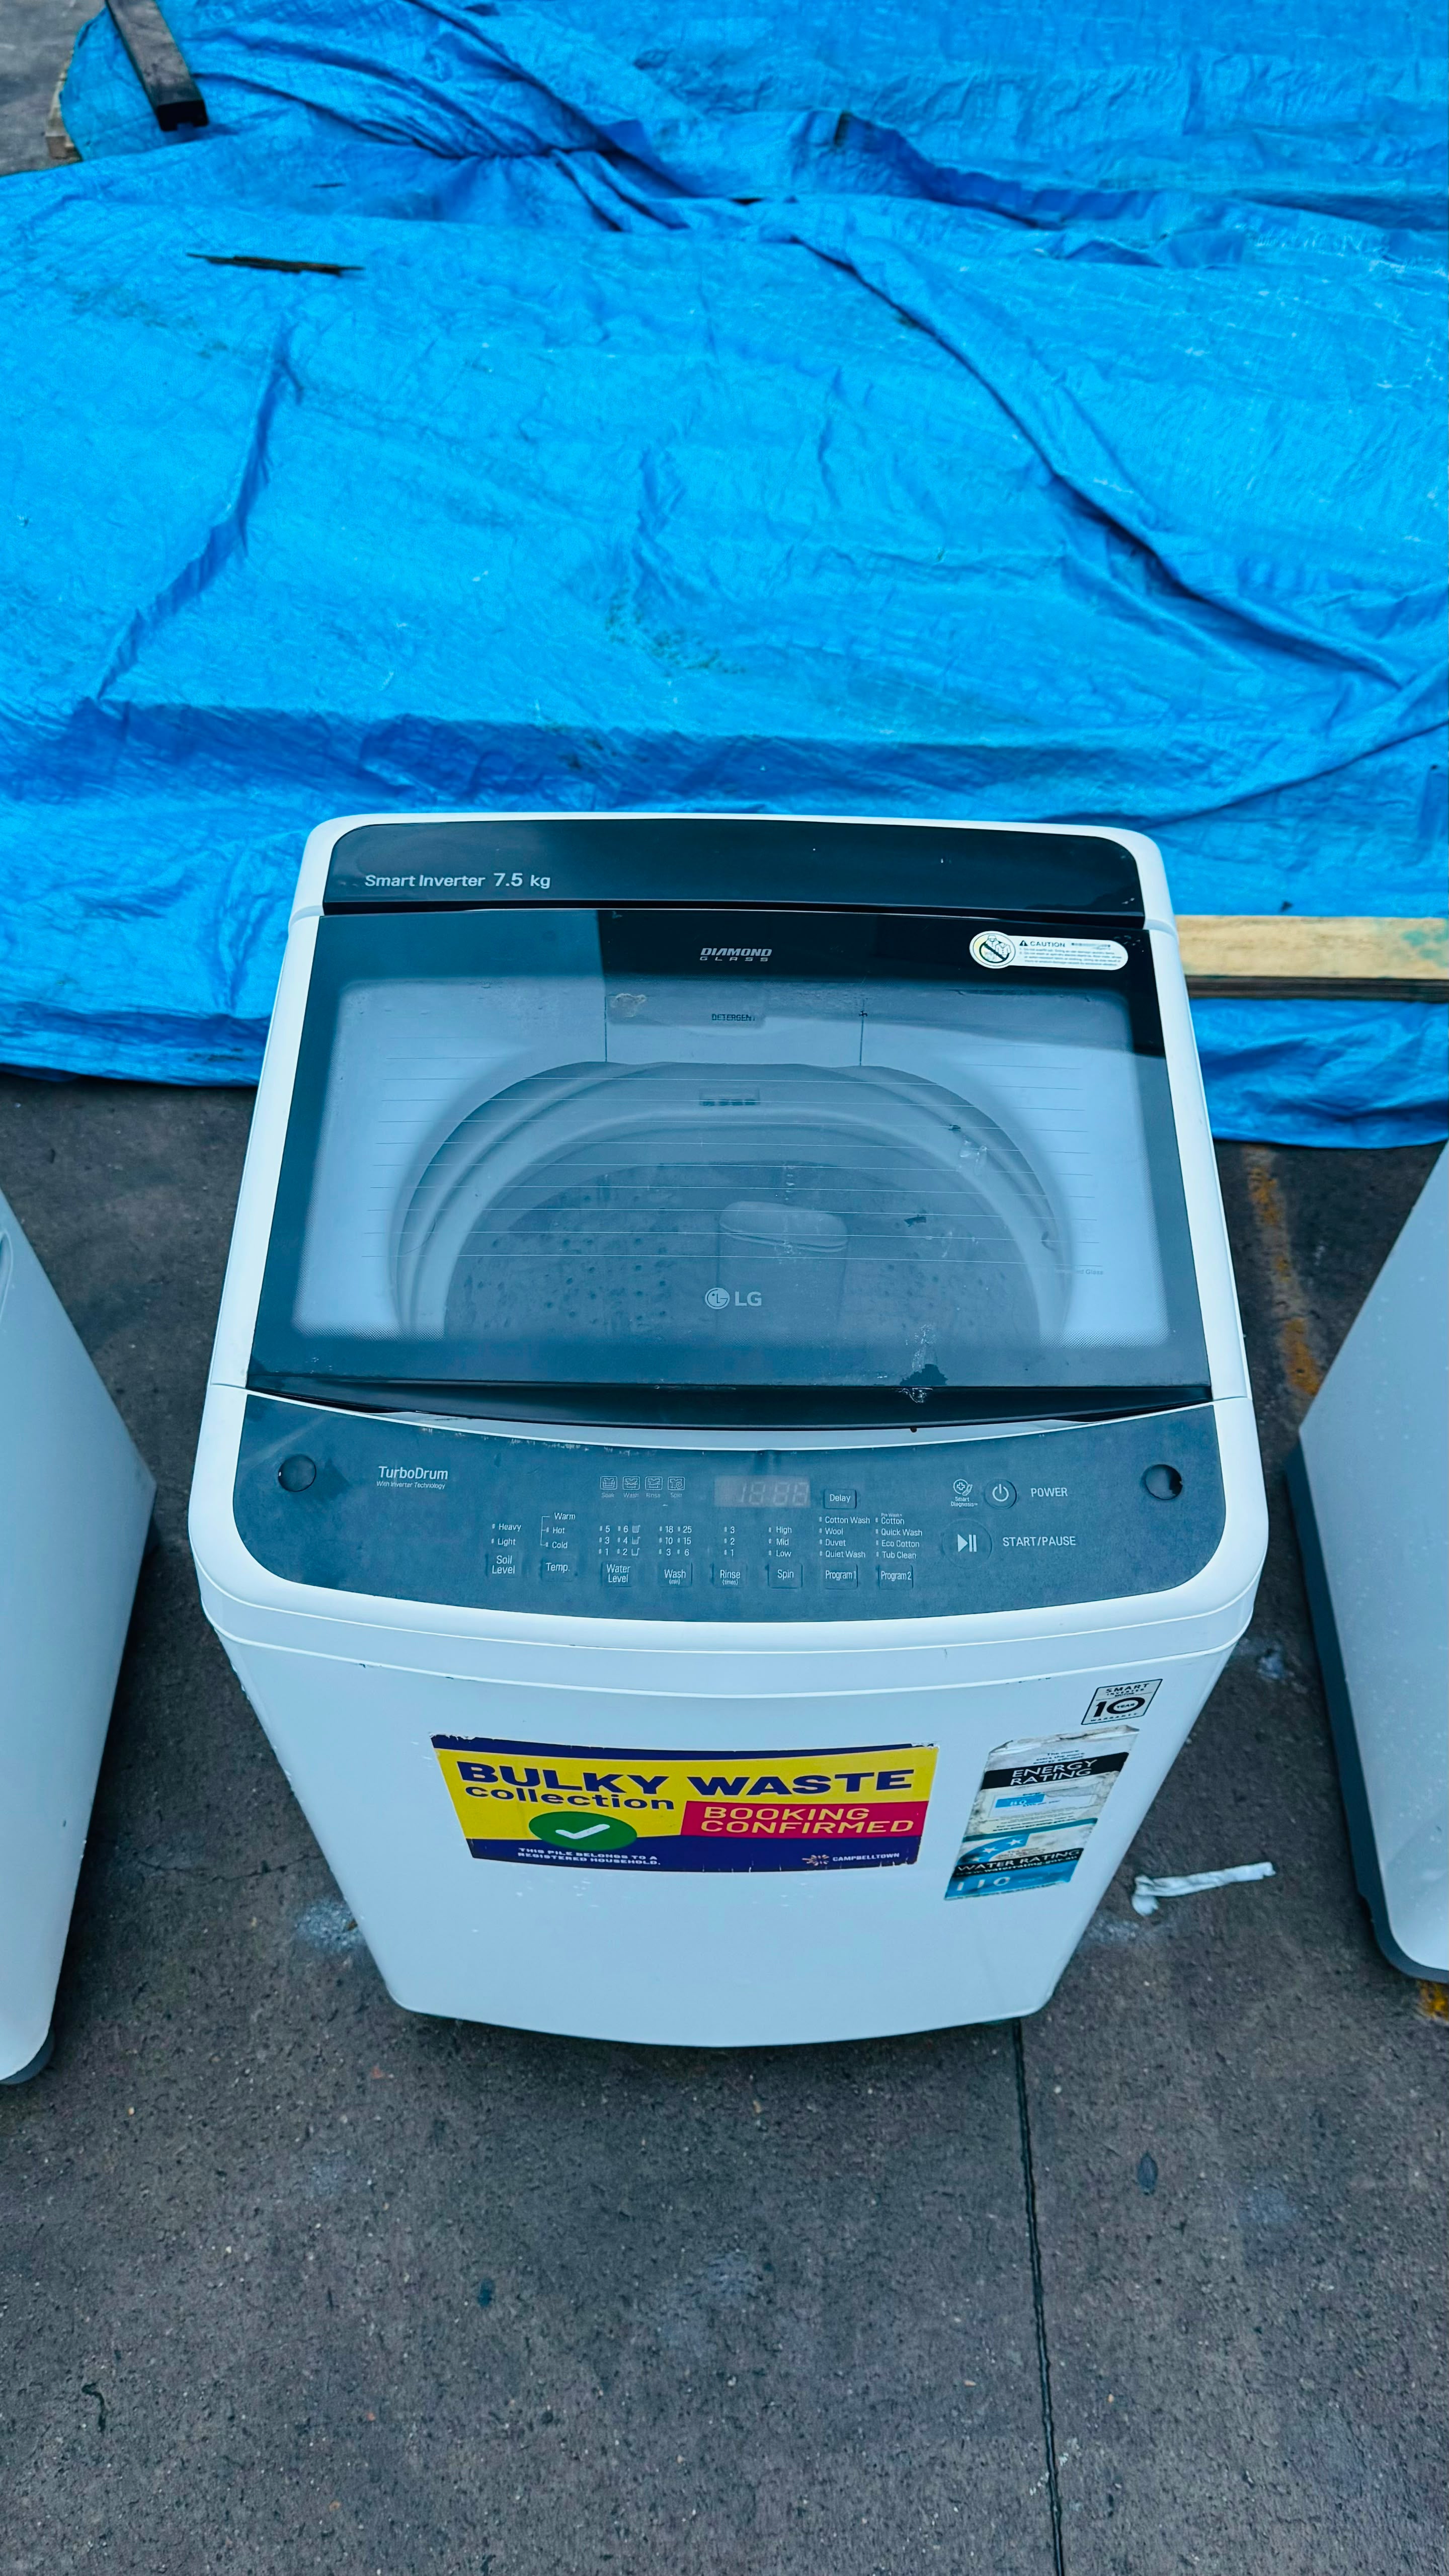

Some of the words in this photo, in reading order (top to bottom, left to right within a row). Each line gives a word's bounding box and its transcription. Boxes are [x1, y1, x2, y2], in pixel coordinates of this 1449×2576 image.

[365, 874, 415, 887] Smart
[419, 874, 486, 887] Inverter
[494, 872, 523, 887] 7.5
[530, 874, 550, 889] kg
[700, 948, 772, 956] DIAMOND
[735, 1291, 762, 1307] LG
[378, 1466, 448, 1480] TurboDrum
[414, 1482, 446, 1490] Technology
[1031, 1487, 1068, 1497] POWER
[830, 1494, 851, 1503] Delay
[554, 1512, 576, 1520] Warm
[499, 1523, 521, 1532] Heavy
[605, 1525, 610, 1533] 5
[623, 1525, 628, 1533] 6
[776, 1526, 792, 1535] High
[498, 1538, 516, 1547] Light
[896, 1540, 920, 1548] Cotton
[1003, 1536, 1076, 1547] START/PAUSE
[496, 1555, 512, 1564] Soil
[897, 1551, 917, 1559] Clean
[492, 1565, 515, 1574] Level
[546, 1562, 570, 1573] Temp.
[606, 1564, 631, 1573] Water
[608, 1574, 628, 1583] Level
[664, 1569, 686, 1579] Wash
[720, 1569, 741, 1579] Rinse
[777, 1569, 794, 1580] Spin
[826, 1570, 852, 1581] Program
[881, 1570, 906, 1582] Program
[907, 1571, 912, 1580] 2
[1105, 1683, 1150, 1694] SMART
[1012, 1759, 1098, 1778] ENERGY
[456, 1761, 670, 1795] BULKY
[686, 1768, 915, 1796] WASTE
[1010, 1768, 1092, 1786] RATING
[465, 1786, 675, 1810] collection
[704, 1806, 870, 1821] BOOKING
[700, 1820, 914, 1834] CONFIRMED
[517, 1853, 587, 1862] REGISTERED
[833, 1853, 900, 1862] CAMPBELLTOWN
[957, 1860, 1014, 1872] WATER
[1019, 1849, 1080, 1864] RATING
